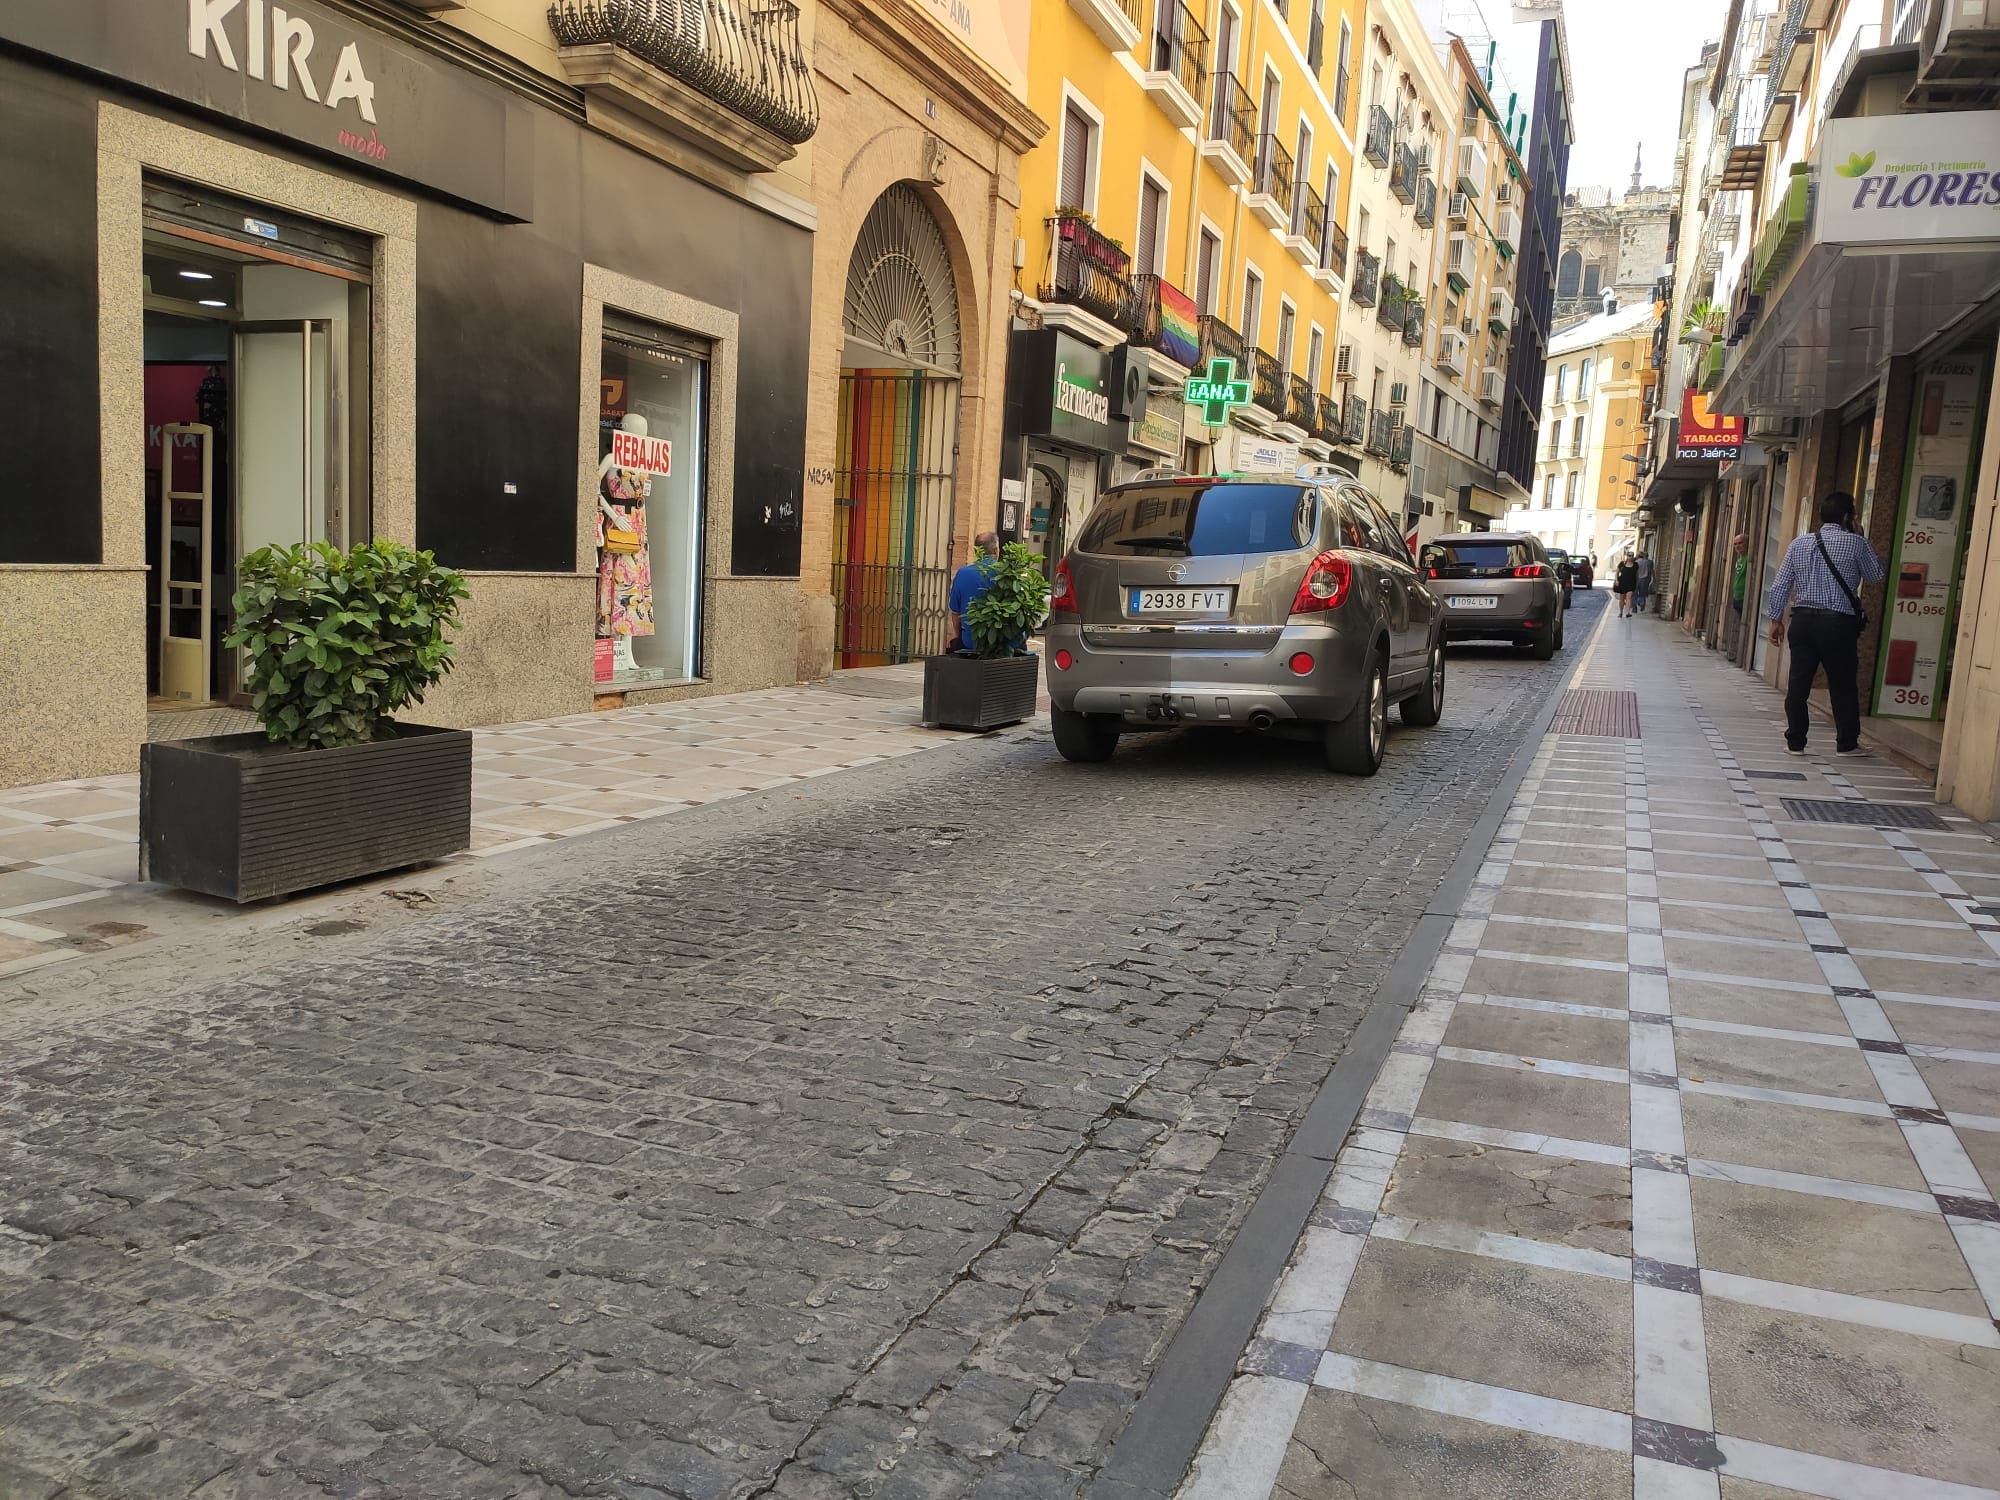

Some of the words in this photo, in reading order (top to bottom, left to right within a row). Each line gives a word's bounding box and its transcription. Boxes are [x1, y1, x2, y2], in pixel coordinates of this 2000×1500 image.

[188, 0, 377, 125] KIRA
[338, 128, 387, 160] moda
[1852, 171, 2000, 210] FLORES
[1056, 362, 1109, 426] farmacia
[1684, 434, 1738, 443] TABACOS
[614, 433, 669, 474] REBAJAS
[1701, 448, 1737, 458] Jaén-2
[1904, 531, 1934, 545] 26€
[1144, 593, 1185, 609] 2938
[1192, 593, 1224, 609] FVT
[1897, 601, 1946, 616] 10,95€
[1894, 689, 1930, 706] 39€
